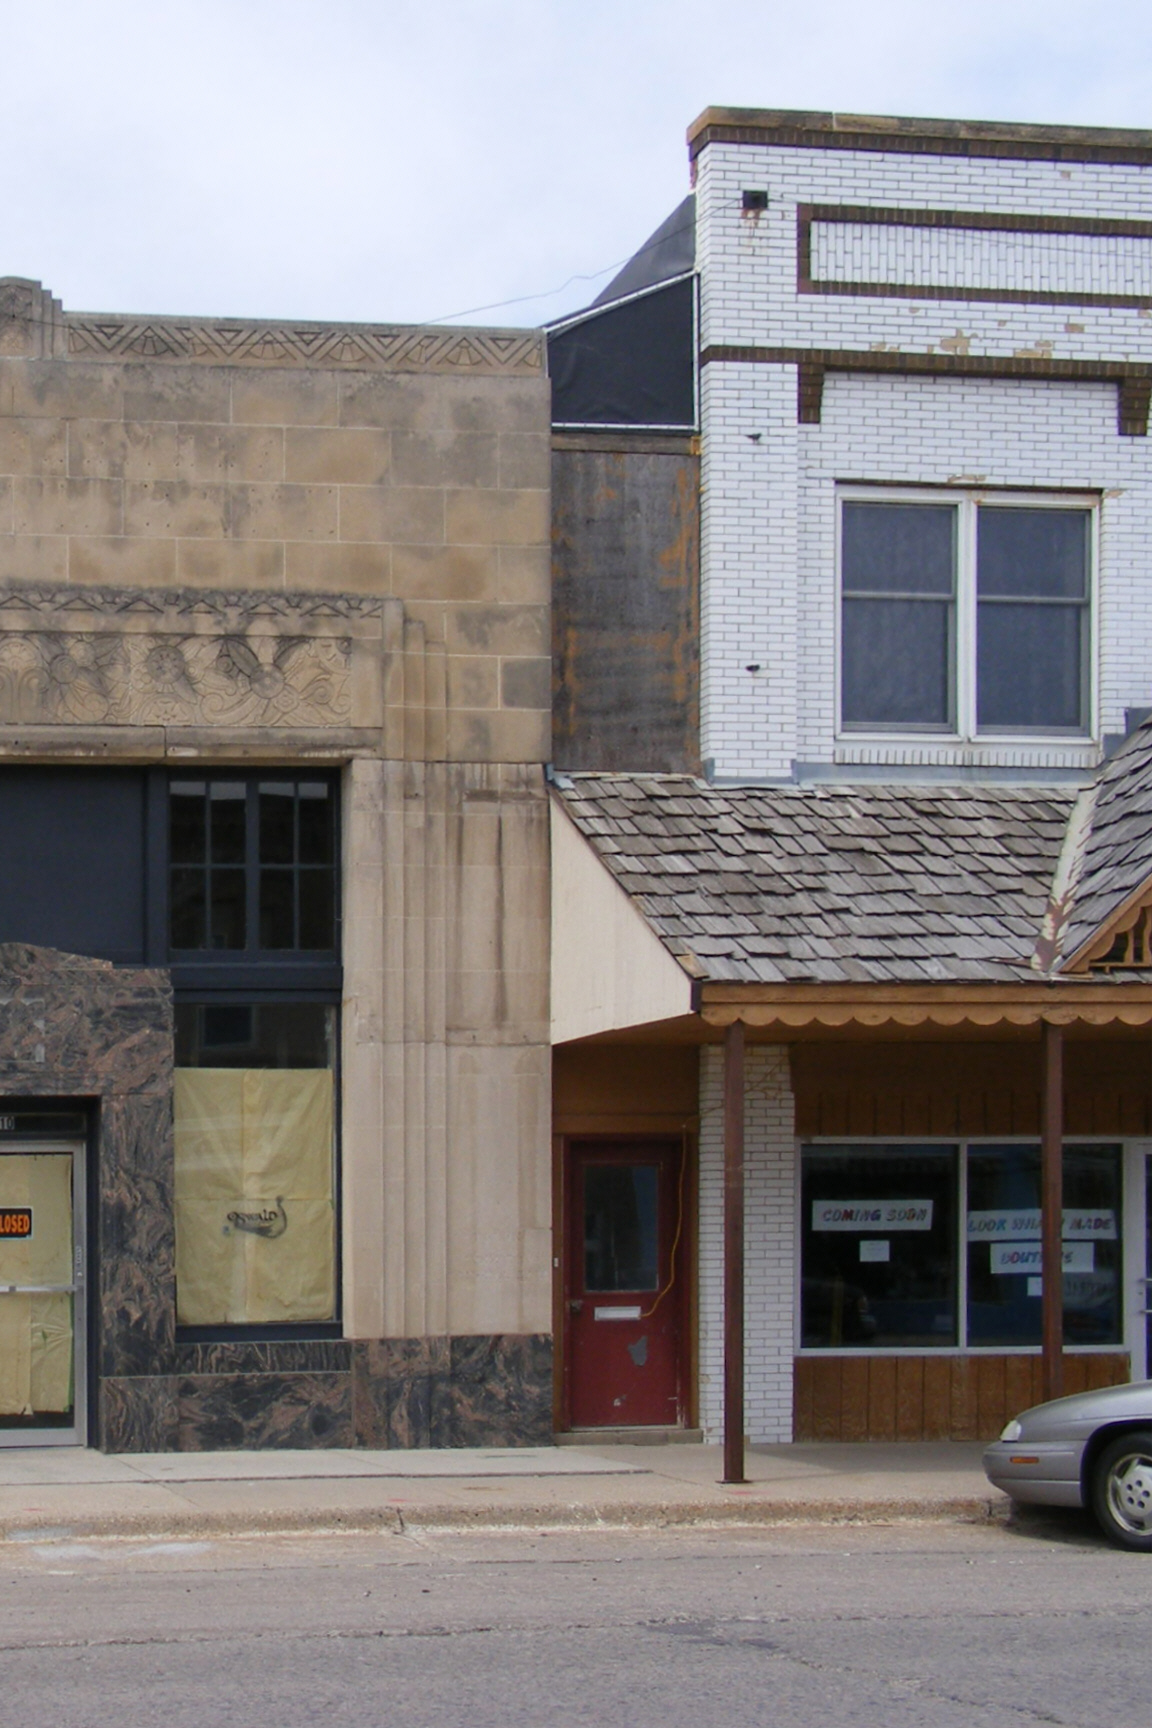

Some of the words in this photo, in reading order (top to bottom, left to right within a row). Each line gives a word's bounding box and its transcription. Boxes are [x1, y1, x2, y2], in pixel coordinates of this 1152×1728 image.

[822, 1208, 882, 1222] COMING
[886, 1207, 928, 1222] SOON
[967, 1218, 1007, 1233] LOOK
[1069, 1217, 1113, 1231] MADE
